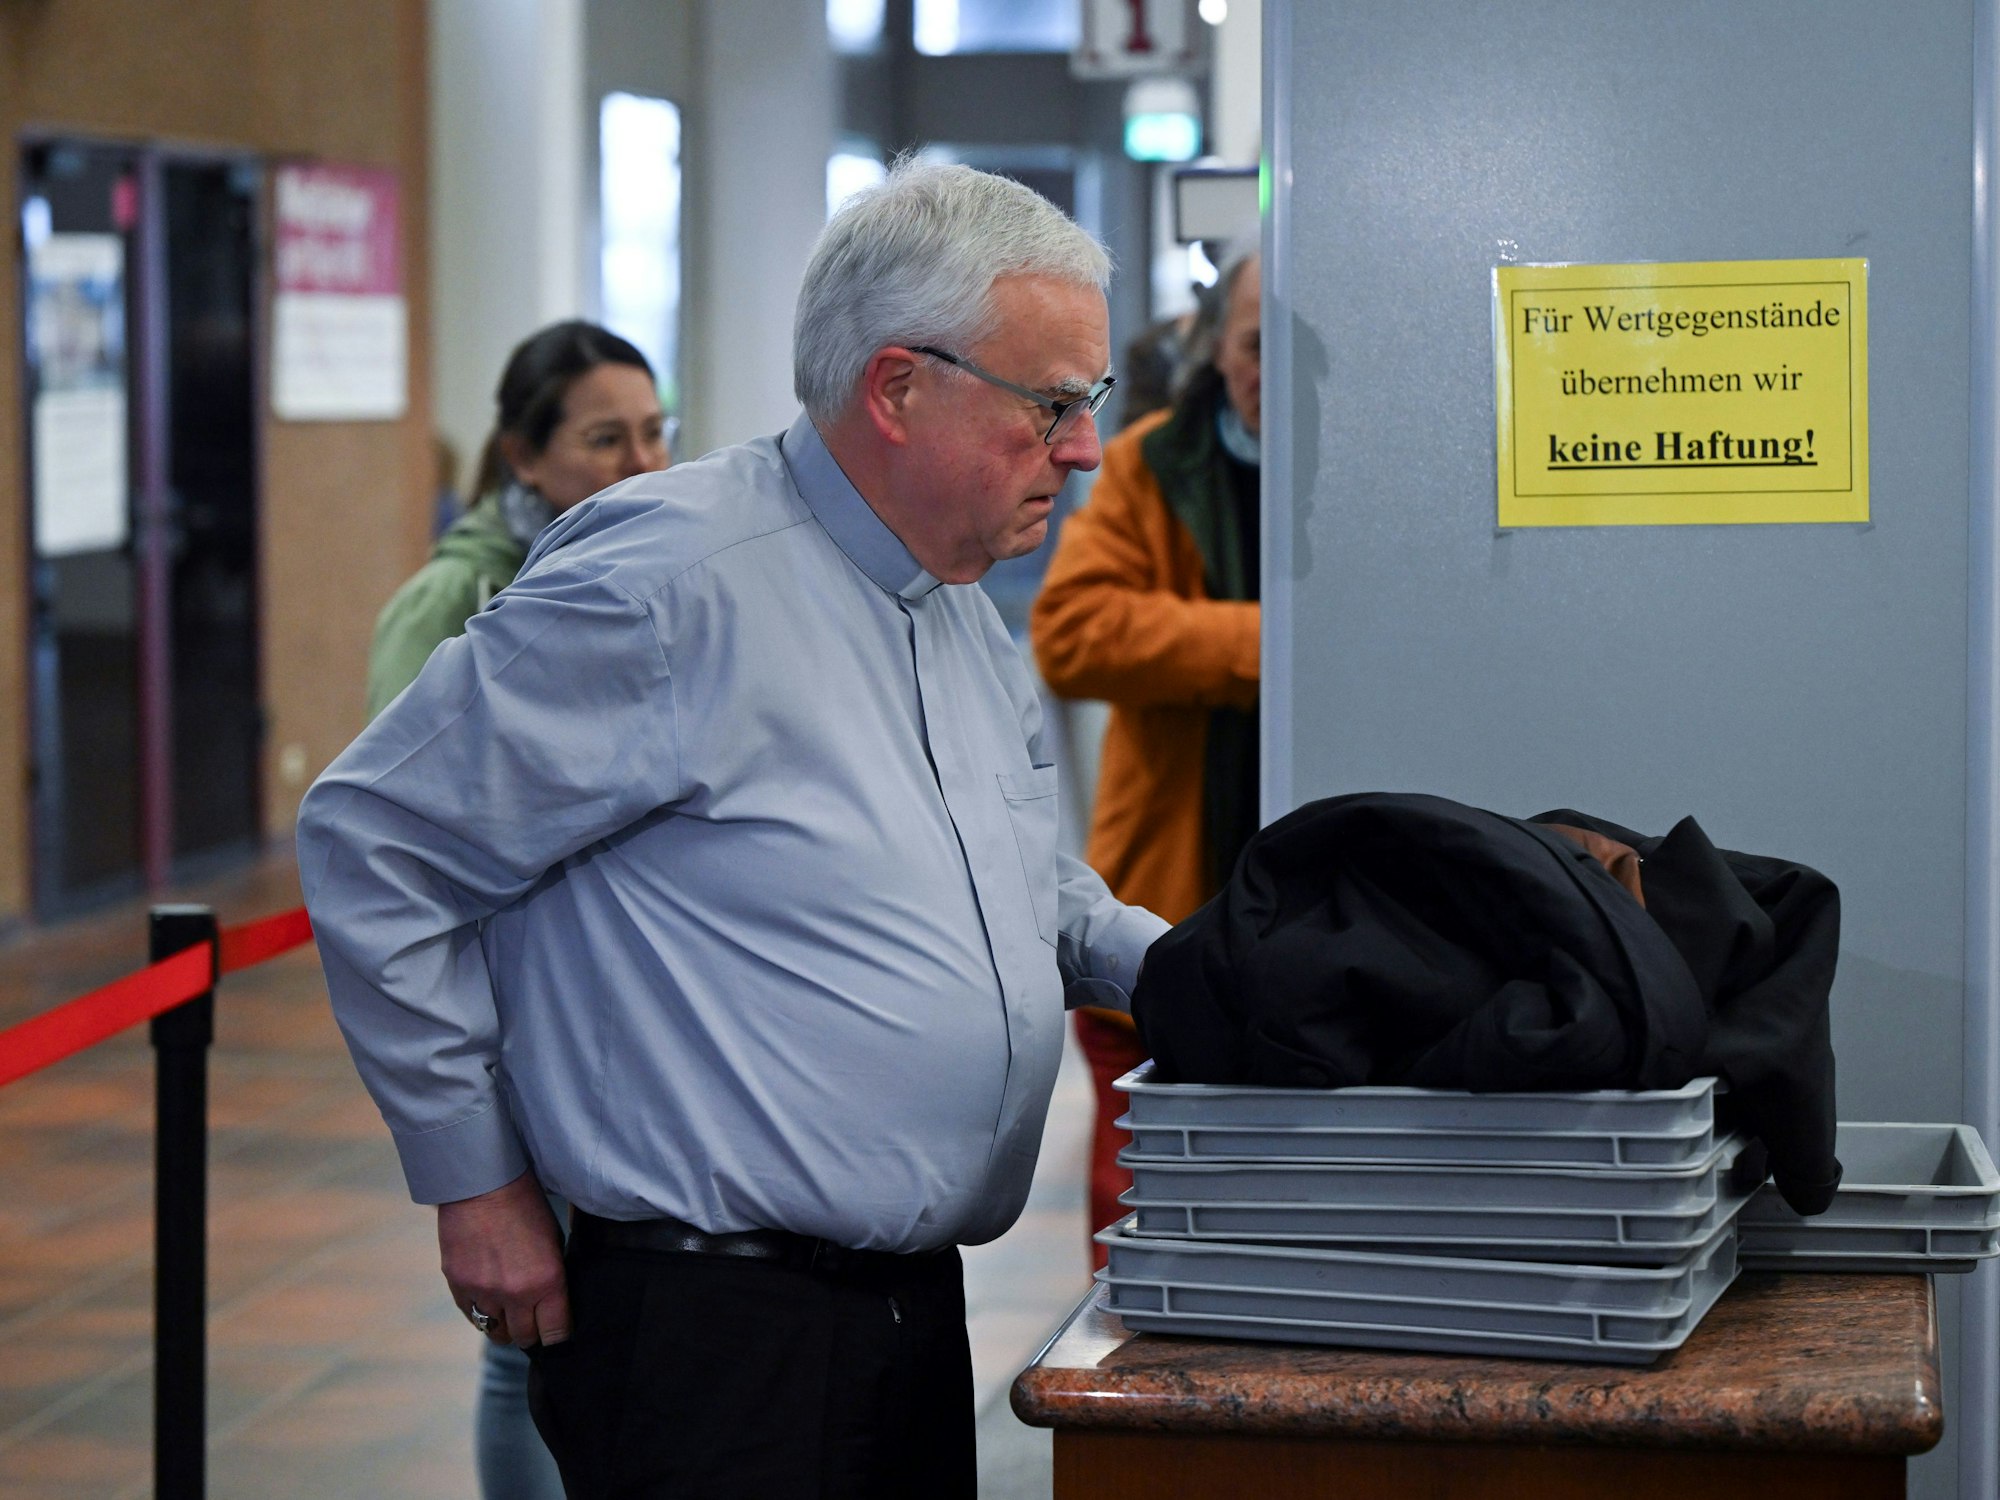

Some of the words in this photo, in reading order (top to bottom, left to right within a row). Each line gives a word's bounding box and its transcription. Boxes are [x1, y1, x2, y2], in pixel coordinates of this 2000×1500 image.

[1523, 308, 1574, 334] Für
[1583, 300, 1841, 337] Wertgegenstände
[1561, 367, 1742, 396] übernehmen
[1753, 364, 1803, 391] wir
[1548, 433, 1642, 465] keine
[1655, 429, 1815, 466] Haftung!
